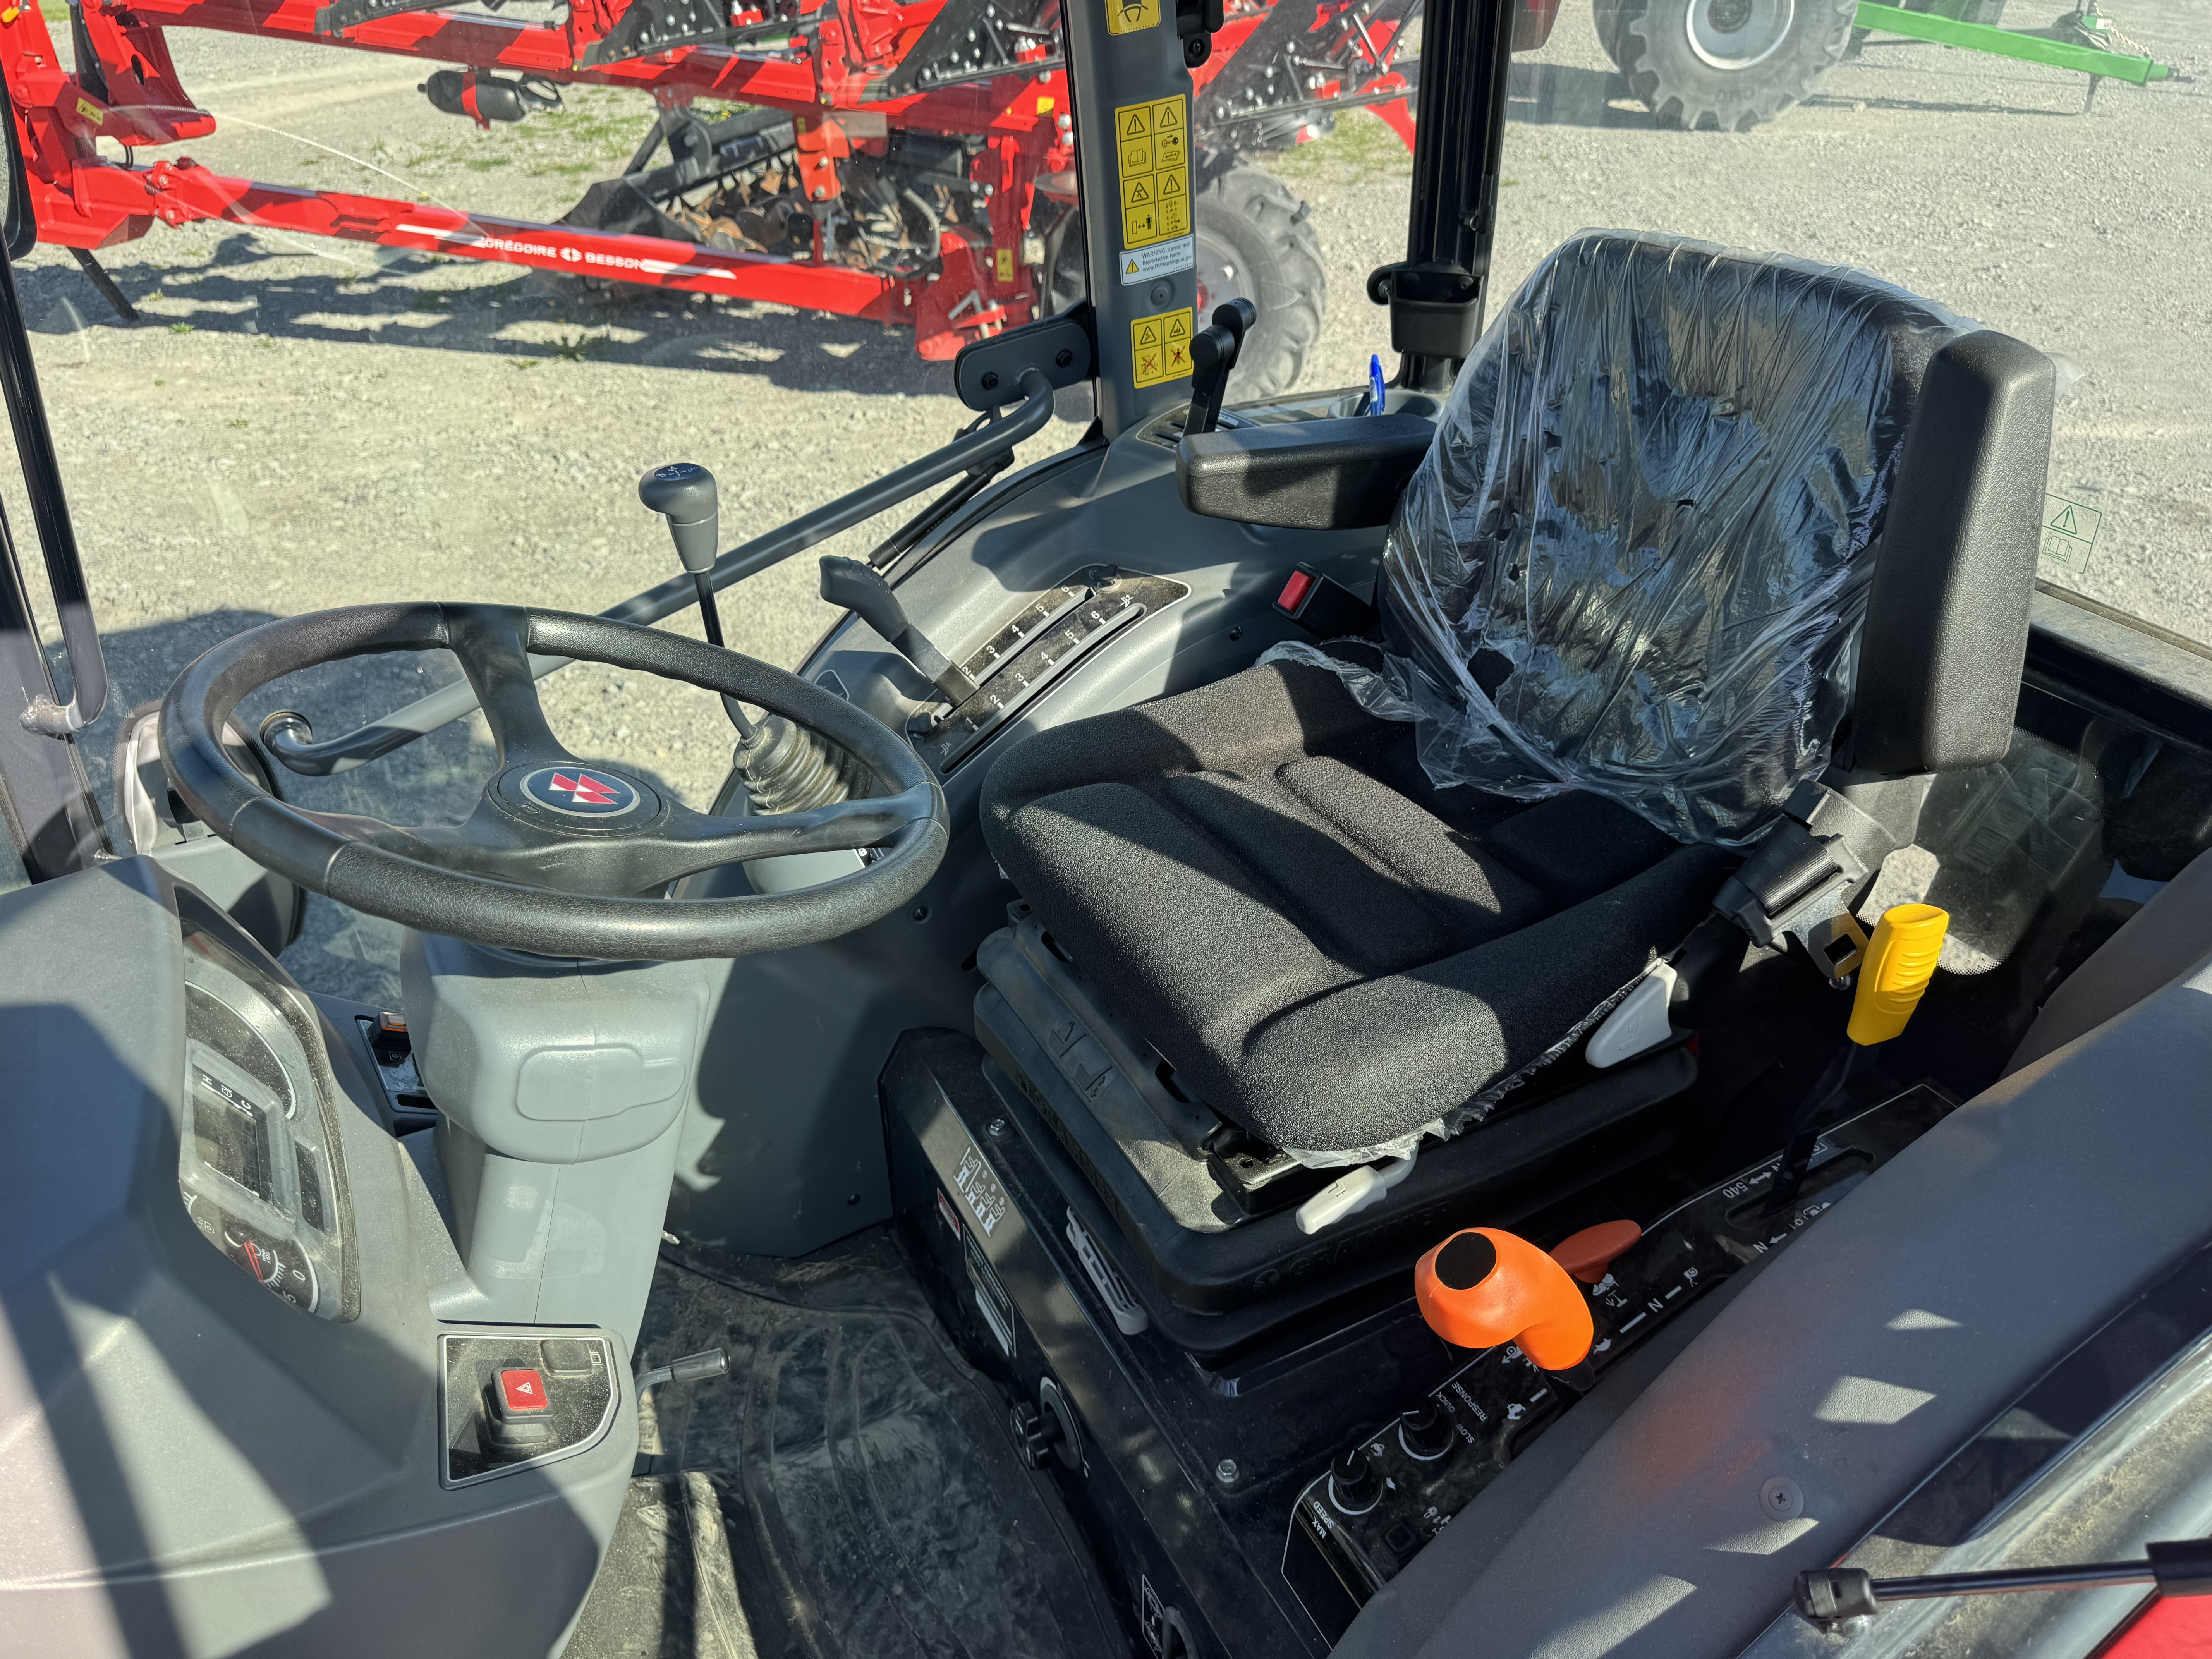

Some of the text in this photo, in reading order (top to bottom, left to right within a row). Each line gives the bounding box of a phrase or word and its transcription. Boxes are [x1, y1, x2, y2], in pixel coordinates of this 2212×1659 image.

[584, 251, 645, 271] BESSON
[1142, 254, 1168, 266] Reproductive
[1035, 603, 1044, 612] 5
[1091, 611, 1100, 619] 6
[1012, 625, 1020, 633] 4
[1065, 630, 1074, 639] 5
[986, 645, 995, 654] 3
[1041, 651, 1049, 660] 4
[962, 666, 971, 675] 2
[1015, 673, 1024, 682] 3
[990, 695, 1000, 704] 2
[202, 1074, 212, 1085] H
[241, 1100, 251, 1109] C
[1722, 1182, 1748, 1198] 540
[1753, 1241, 1769, 1254] N
[293, 1270, 306, 1281] 0
[283, 1291, 297, 1303] 5
[1647, 1298, 1664, 1313] N
[1436, 1391, 1456, 1413] QUICK
[1452, 1381, 1488, 1422] RESPONSE
[1456, 1424, 1475, 1444] SLOW
[1313, 1501, 1334, 1528] SPEED
